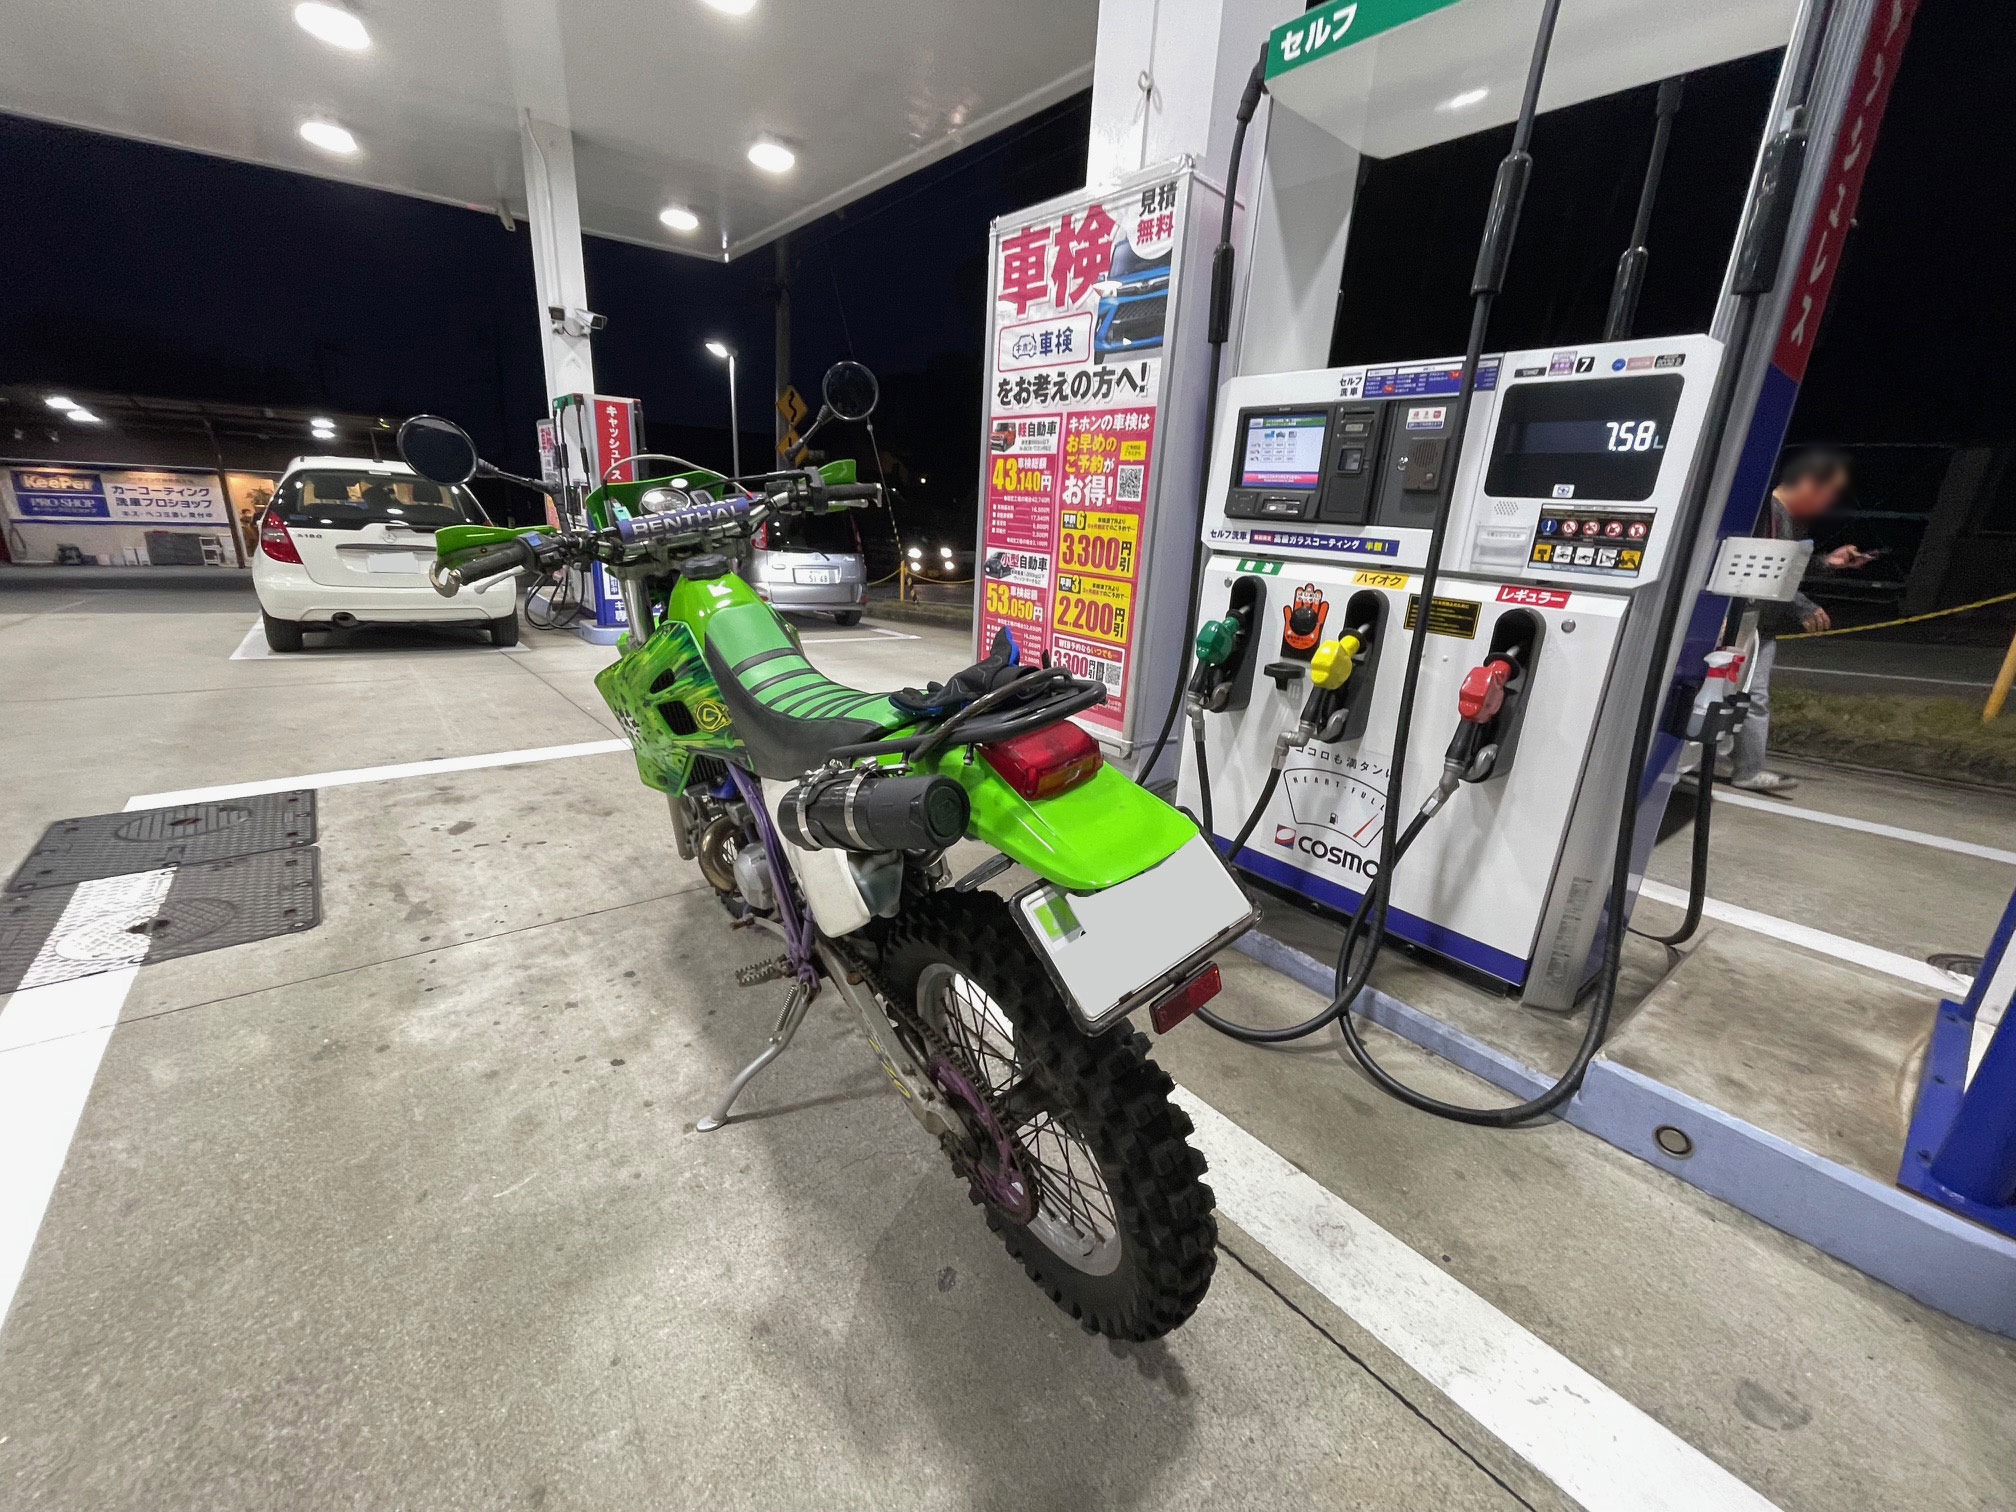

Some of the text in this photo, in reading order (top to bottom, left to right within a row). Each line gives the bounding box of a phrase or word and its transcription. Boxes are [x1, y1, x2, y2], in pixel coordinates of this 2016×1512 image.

[1281, 3, 1358, 61] セルフ
[1139, 181, 1177, 217] 見積
[1137, 211, 1173, 246] 無料
[998, 204, 1116, 316] 車検
[1040, 326, 1074, 356] 車検
[1580, 359, 1590, 371] 7
[998, 362, 1148, 406] をお考えの方へ!
[1340, 376, 1362, 387] セルフ
[1018, 420, 1057, 438] 軽自動車
[1069, 413, 1150, 432] キホンの車検は
[605, 405, 622, 480] キャッシュレス
[1066, 433, 1117, 453] お早めの
[1653, 435, 1664, 449] L
[1065, 454, 1115, 473] ご予約が
[23, 474, 91, 490] KeePer
[993, 458, 1052, 492] 43,140円
[111, 485, 209, 497] カーコーティング
[1062, 474, 1114, 507] お得!
[31, 498, 95, 508] PRO SHOP
[631, 505, 742, 536] RENTHAL
[1210, 529, 1247, 541] セルフ洗車
[1001, 553, 1048, 571] 小型自動車
[1357, 574, 1402, 586] ハイオク
[987, 582, 1043, 622] 53,050円
[1502, 588, 1564, 604] レギュラー
[1298, 836, 1380, 880] COSMO
